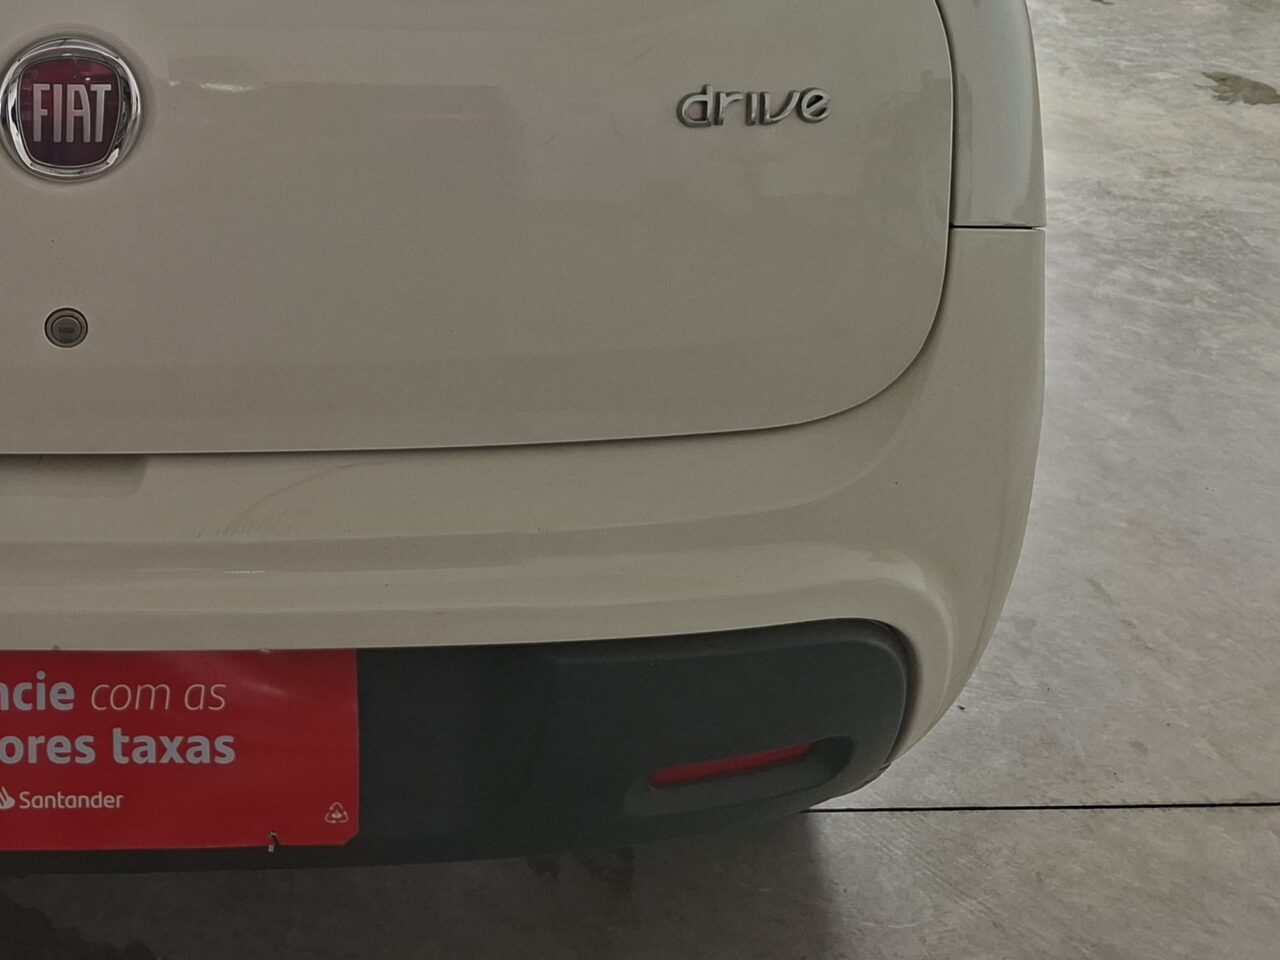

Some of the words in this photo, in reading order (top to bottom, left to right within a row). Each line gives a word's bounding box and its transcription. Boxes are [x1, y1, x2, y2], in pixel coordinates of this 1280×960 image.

[32, 83, 112, 143] FIAT
[677, 84, 831, 128] drive
[91, 683, 170, 711] com
[184, 683, 227, 711] as
[112, 727, 236, 764] taxas
[19, 791, 124, 809] Santander
